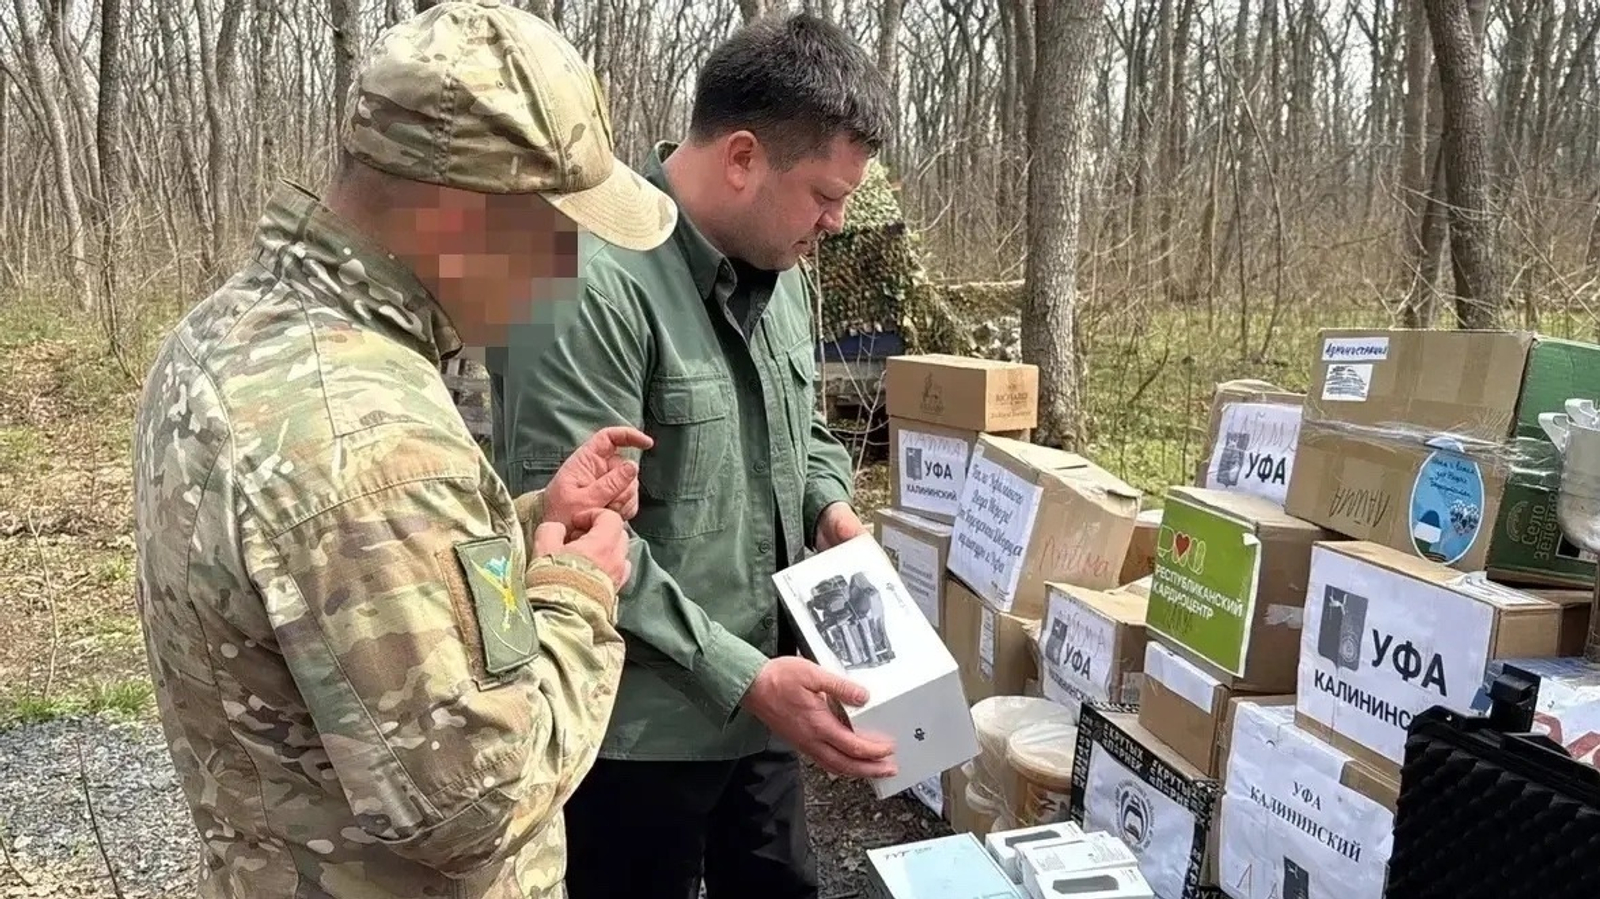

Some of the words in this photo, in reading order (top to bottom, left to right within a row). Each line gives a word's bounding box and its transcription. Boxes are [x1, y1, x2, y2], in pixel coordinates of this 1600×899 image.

[924, 460, 954, 481] УФА
[1245, 452, 1286, 485] УФА
[906, 484, 958, 502] КАЛИНИНСКИЙ
[1521, 505, 1546, 545] Село
[1152, 581, 1214, 620] КАРДИОЦЕНТР
[1155, 564, 1244, 618] РЕСПУБЛИКАНСКИЙ
[1064, 643, 1091, 681] УФА
[1371, 629, 1447, 697] УФА
[1314, 668, 1415, 731] КАЛИНИНС
[1292, 781, 1322, 811] УФА
[1249, 786, 1362, 864] КАЛИНИНСКИЙ
